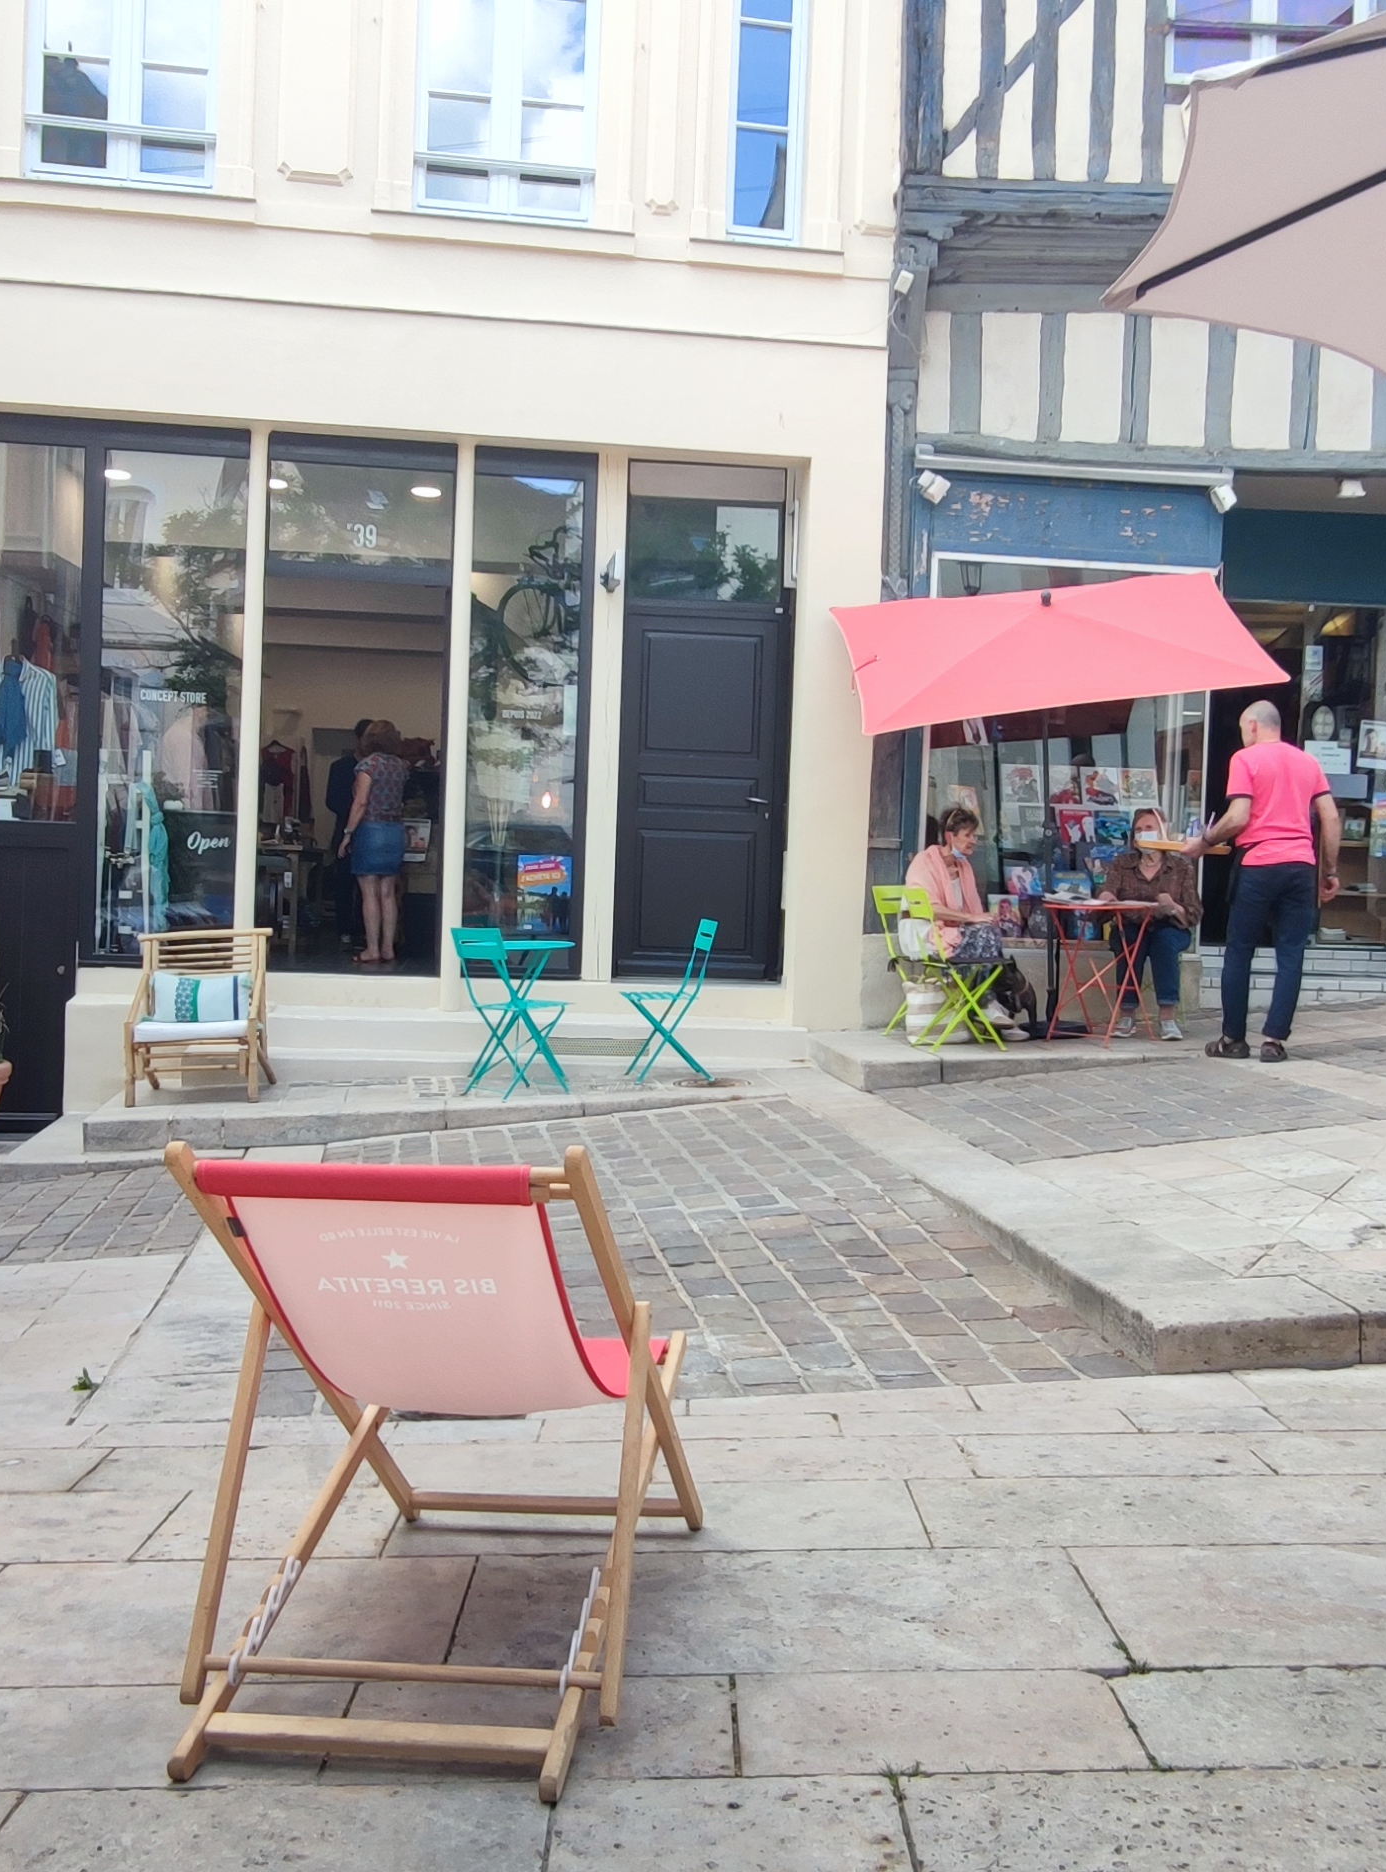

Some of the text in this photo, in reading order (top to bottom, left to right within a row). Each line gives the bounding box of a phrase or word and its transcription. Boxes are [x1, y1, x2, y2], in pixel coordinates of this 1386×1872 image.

[140, 688, 208, 704] CONCEPT STORE
[502, 709, 542, 720] DEPUIS 2022
[187, 830, 231, 854] Open
